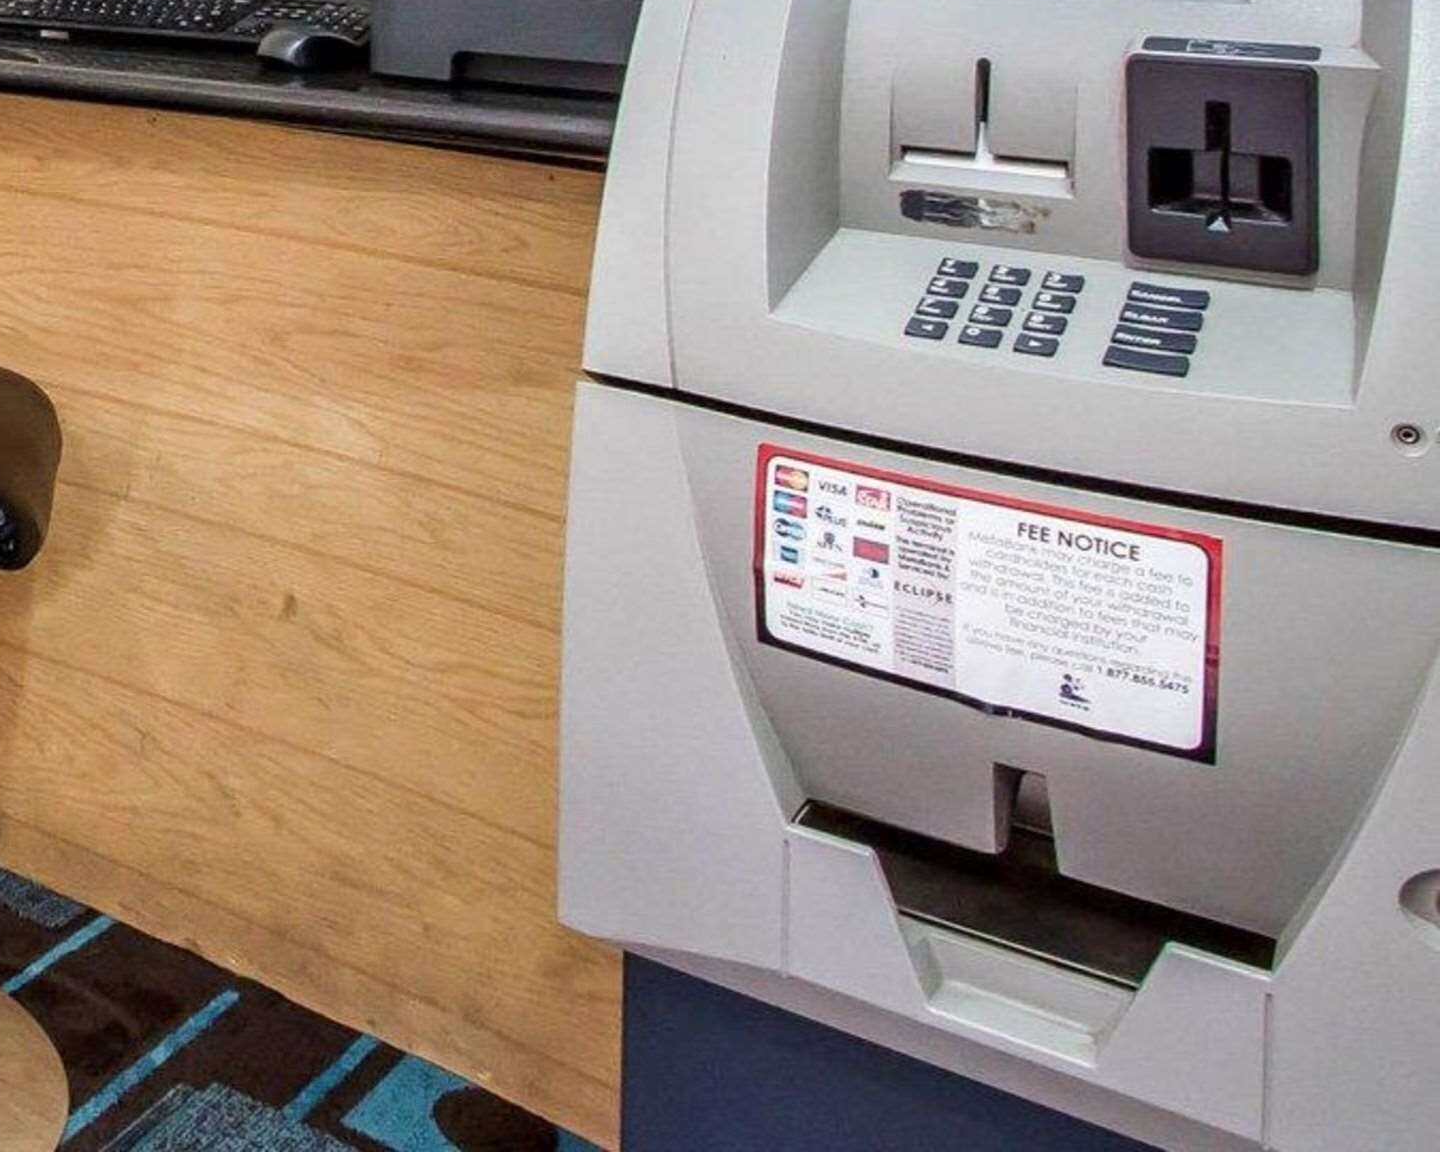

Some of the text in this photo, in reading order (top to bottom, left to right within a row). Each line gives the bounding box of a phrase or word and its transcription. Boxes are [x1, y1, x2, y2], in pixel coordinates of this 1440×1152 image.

[818, 479, 848, 496] VISA
[1017, 522, 1141, 563] FEE NOTICE
[1077, 553, 1129, 576] charge
[1135, 567, 1144, 577] a
[1177, 574, 1192, 587] to
[893, 580, 953, 604] ECLIPSE
[1093, 571, 1131, 588] each
[1137, 580, 1172, 596] cash
[1118, 588, 1171, 610] added
[1176, 601, 1190, 614] to
